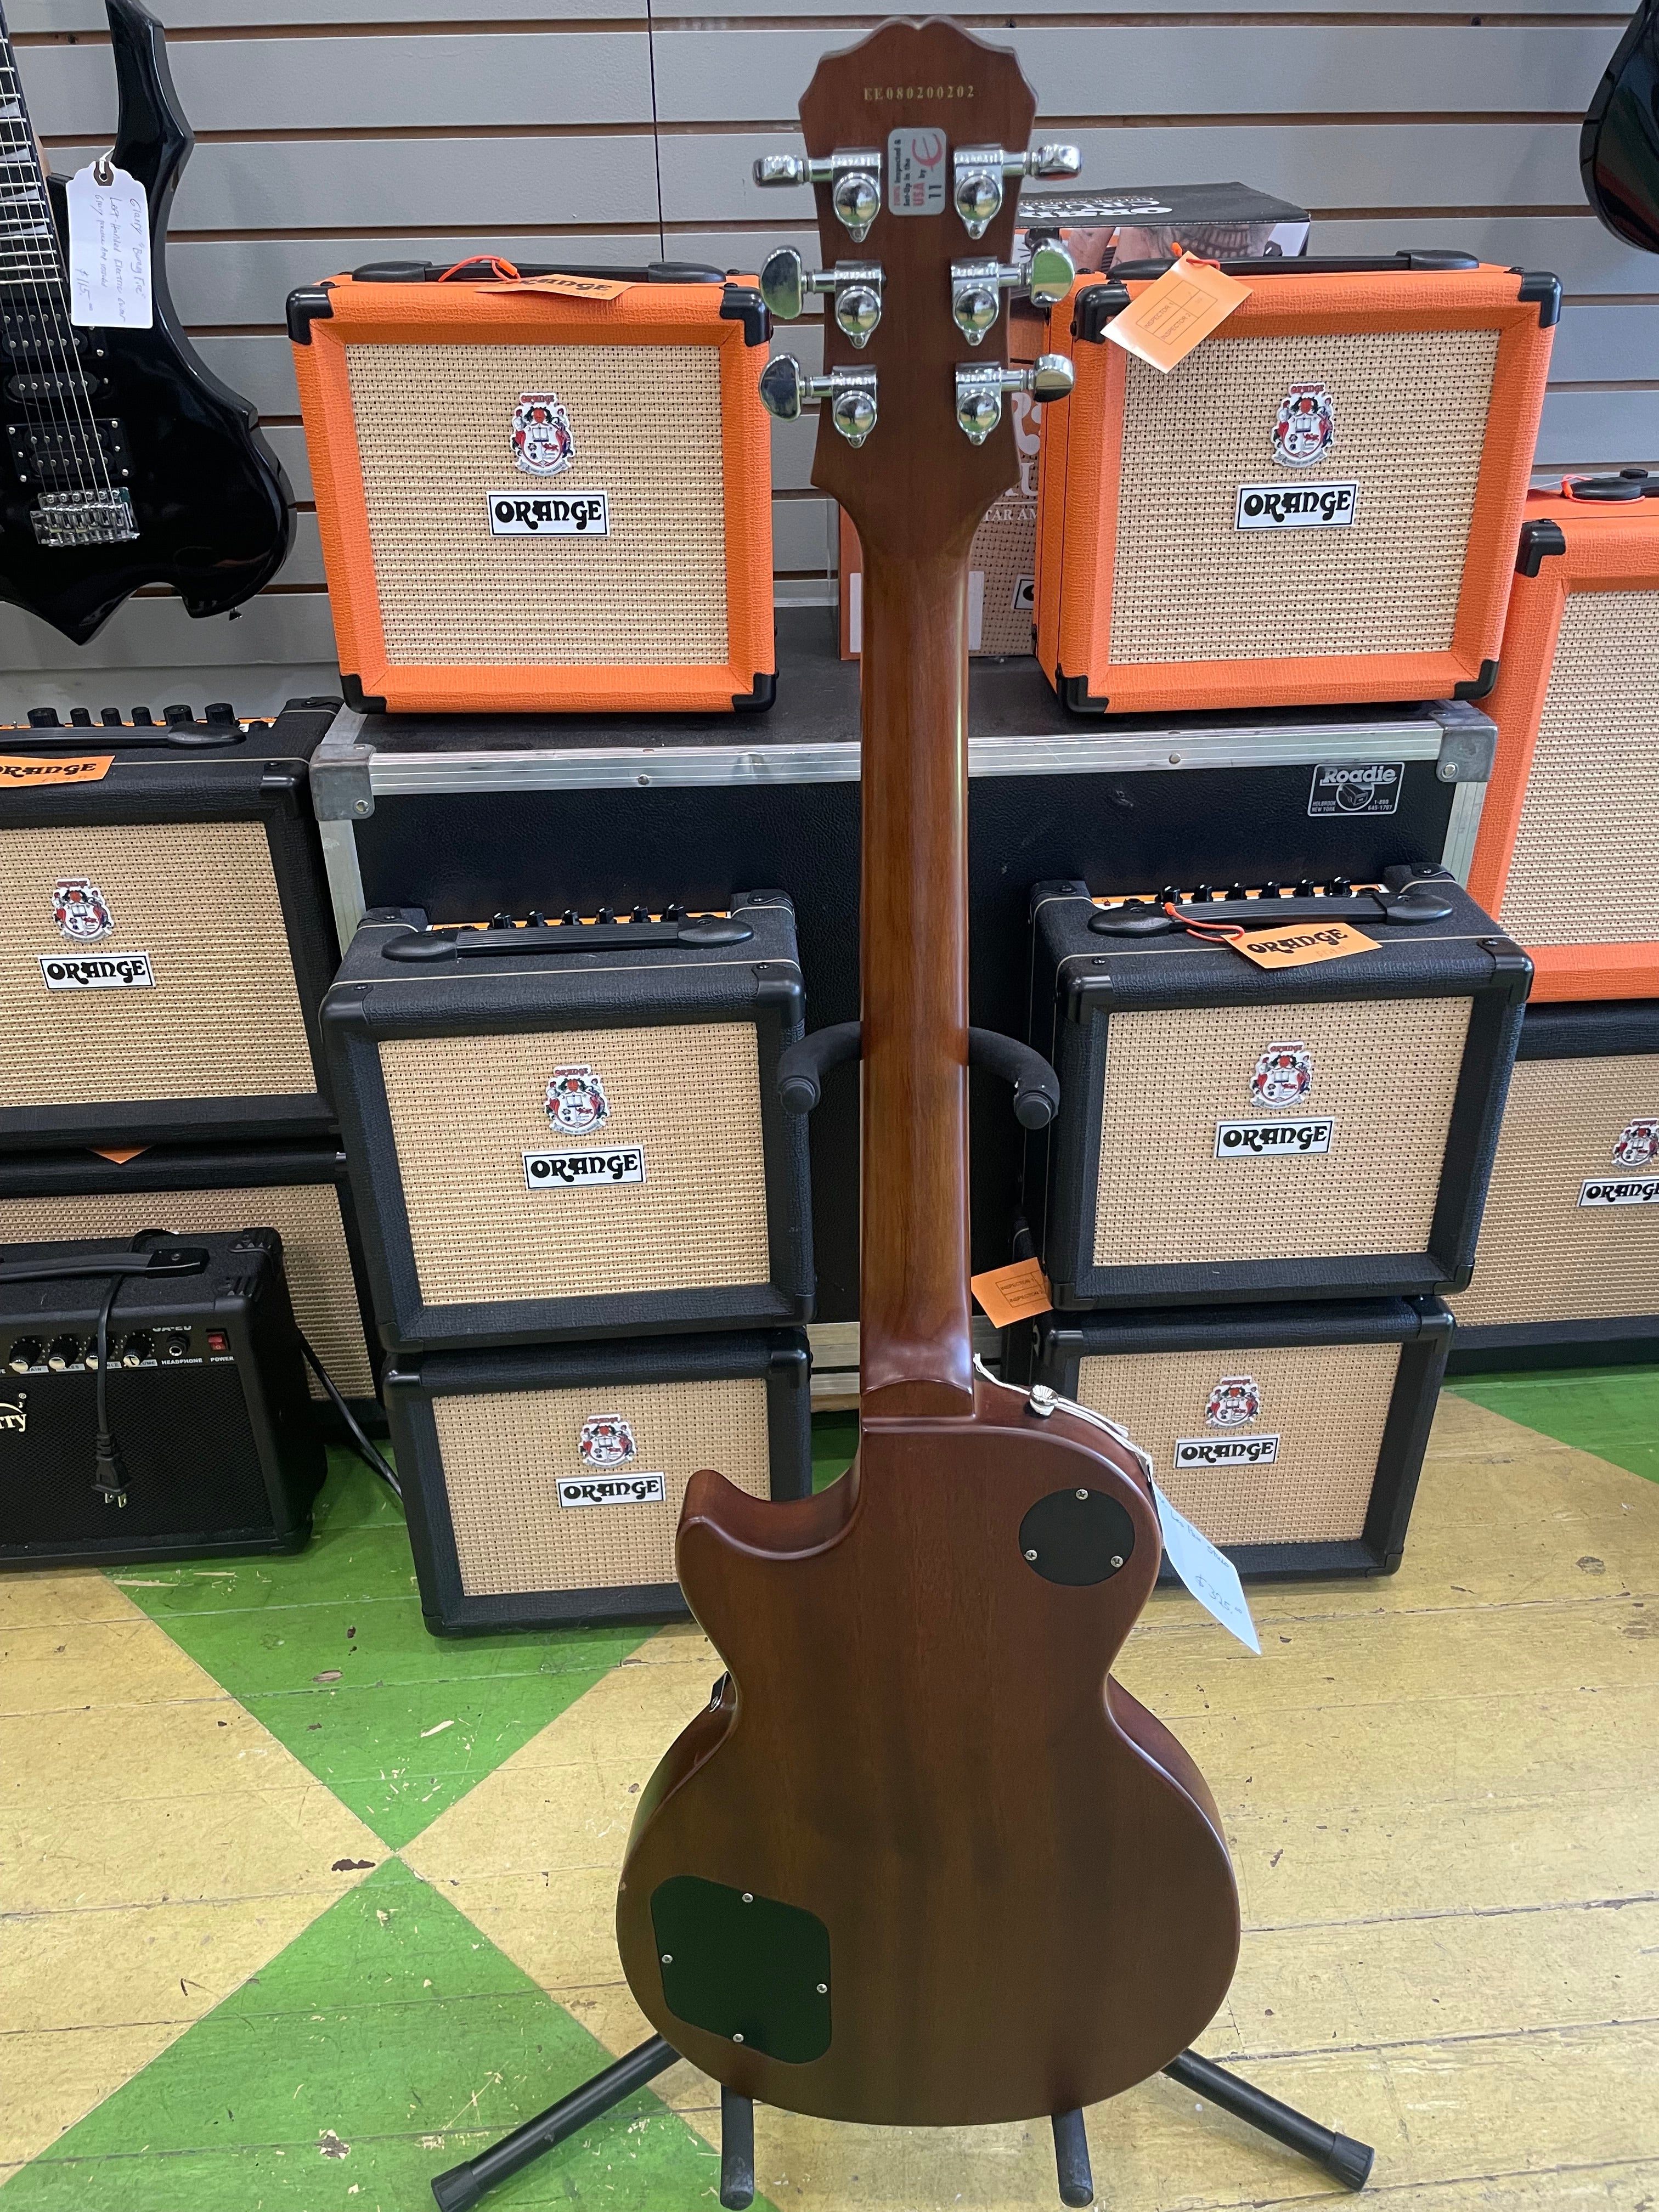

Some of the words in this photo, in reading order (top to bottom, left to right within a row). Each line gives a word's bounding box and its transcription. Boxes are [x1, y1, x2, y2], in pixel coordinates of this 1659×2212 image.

[864, 86, 974, 100] EE080200202
[912, 183, 925, 206] USA
[928, 184, 942, 199] 11
[1019, 207, 1173, 218] ORAN
[1144, 305, 1171, 329] INSPECTOR
[1161, 315, 1188, 340] INSPECTOR
[495, 500, 602, 530] ORANGE
[984, 509, 1013, 521] TAR
[1244, 490, 1351, 522] ORANGE
[0, 763, 97, 777] RANGE
[1321, 765, 1397, 785] Roadie
[1246, 929, 1348, 953] ORANGE
[47, 960, 146, 985] ORANGE
[1223, 1126, 1328, 1152] ORANGE
[531, 1154, 638, 1182] ORANGE
[1181, 1442, 1274, 1463] ORANGE
[563, 1480, 659, 1502] ORANGE
